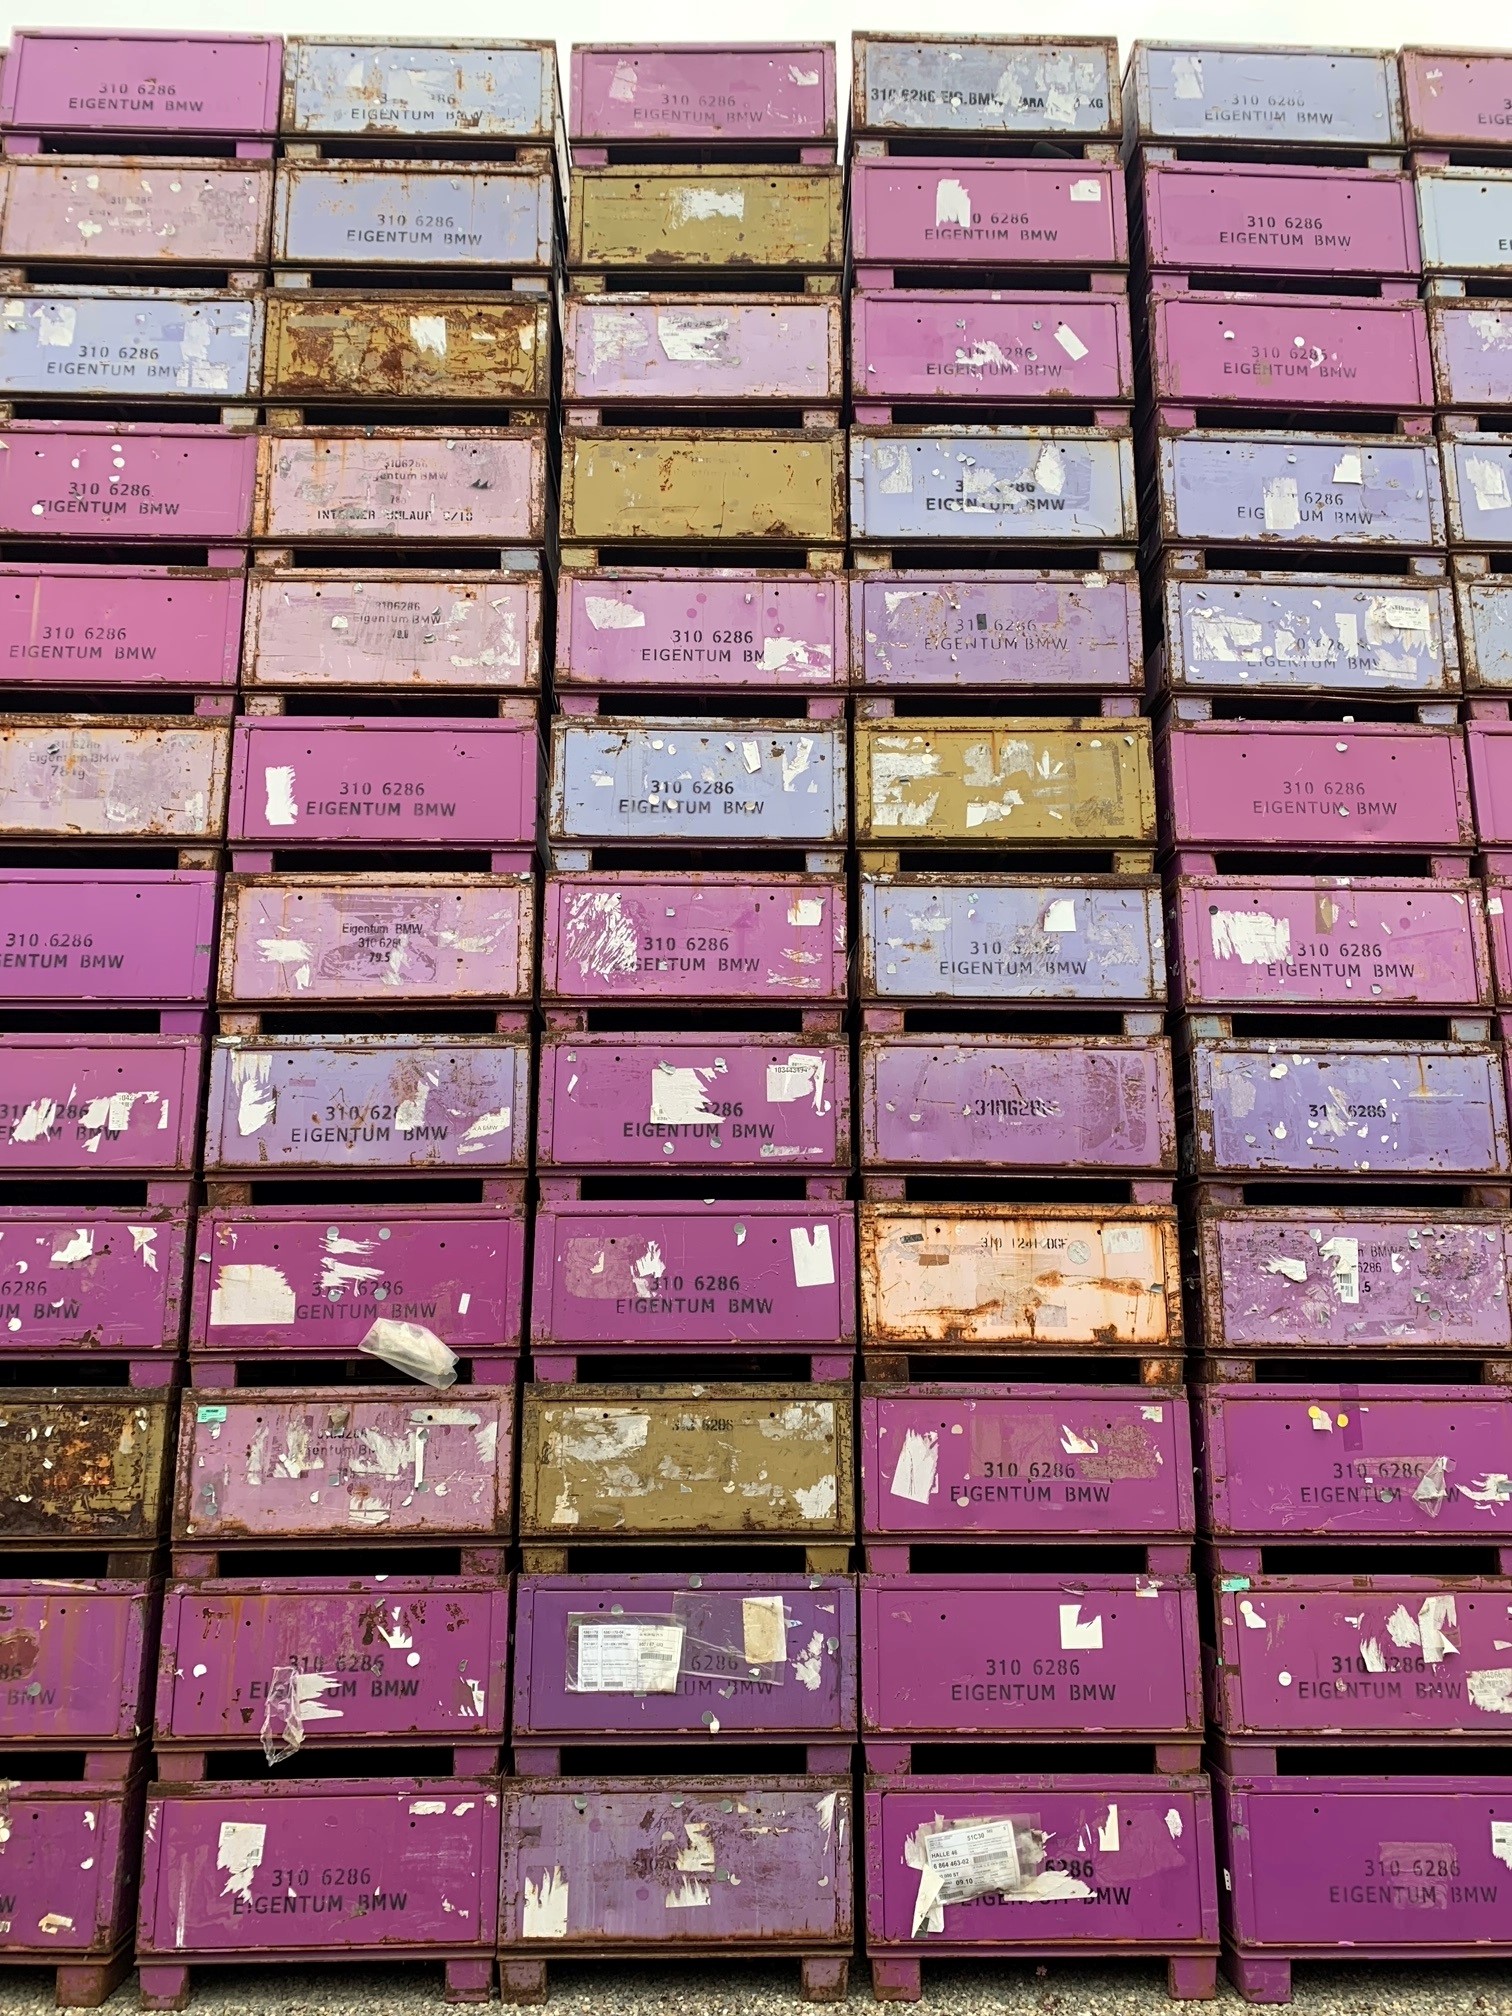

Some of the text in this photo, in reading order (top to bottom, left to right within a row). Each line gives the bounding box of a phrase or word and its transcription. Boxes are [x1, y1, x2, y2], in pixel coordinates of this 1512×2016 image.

[100, 83, 176, 96] 310 6286
[69, 97, 204, 112] EIGENTUM BMW
[661, 94, 735, 107] 310 6286
[1232, 94, 1306, 108] 310 6286
[351, 107, 434, 120] EIGENTUM
[633, 108, 763, 123] EIGENTUM BMW
[1204, 110, 1333, 124] EIGENTUM BMW
[377, 214, 454, 228] 310 6286
[991, 213, 1029, 224] 6286
[1247, 216, 1322, 230] 310 6286
[347, 230, 482, 245] EIGENTUM BMW
[925, 229, 1057, 242] EIGENTUM BMW
[1220, 232, 1351, 247] EIGENTUM BMW
[79, 347, 159, 360] 310 6286
[1252, 346, 1328, 360] 310 6286
[47, 363, 135, 376] EIGENTUM
[1024, 364, 1062, 376] BMW
[1224, 362, 1357, 379] EIGENTUM BMW
[69, 482, 151, 498] 310 6286
[1304, 492, 1343, 505] 6286
[37, 499, 180, 515] EIGENTUM BMW
[1335, 511, 1372, 525] BMW
[412, 615, 440, 624] BMW
[43, 627, 127, 640] 310 6286
[673, 630, 753, 643] 310 6286
[924, 638, 1069, 651] EIGENTUM BMW
[10, 645, 157, 659] EIGENTUM BMW
[642, 648, 764, 663] EIGENTUM BM
[340, 782, 425, 796] 310 6286
[651, 781, 734, 794] 310 6286
[1283, 782, 1365, 795] 310 6286
[306, 802, 456, 817] EIGENTUM BMW
[619, 800, 764, 814] EIGENTUM BMW
[1253, 801, 1397, 815] EIGENTUM BMW
[342, 923, 423, 936] Eigentum BMW
[6, 934, 93, 947] 310 6286
[358, 938, 377, 948] 310
[644, 938, 729, 951] 310 6286
[970, 941, 1002, 954] 310
[370, 952, 390, 963] 79.5
[1298, 944, 1383, 958] 310 6286
[80, 955, 123, 968] BMW
[718, 958, 760, 971] BMW
[940, 962, 1087, 975] EIGENTUM BMW
[1267, 964, 1414, 977] EIGENTUM BMW
[326, 1106, 399, 1121] 310 628
[1348, 1105, 1386, 1118] 6286
[291, 1127, 447, 1143] EIGENTUM BMW
[624, 1123, 775, 1139] EIGENTUM BMW
[1, 1281, 47, 1296] 6286
[649, 1276, 740, 1291] 310 6286
[34, 1304, 80, 1319] BMW
[295, 1303, 437, 1320] GENTUM BMW
[616, 1298, 773, 1314] EIGENTUM BMW
[984, 1463, 1075, 1478] 310 6286
[1333, 1464, 1424, 1479] 310 6286
[950, 1486, 1110, 1501] EIGENTUM BMW
[1301, 1488, 1400, 1502] EIGENTUM
[289, 1655, 385, 1672] 310 6286
[691, 1655, 738, 1671] 6286
[986, 1659, 1080, 1676] 310 6286
[371, 1681, 418, 1697] BMW
[952, 1684, 1116, 1700] EIGENTUM BMW
[1299, 1682, 1461, 1699] EIGENTUM BMW
[967, 1832, 985, 1842] 51C30
[931, 1851, 950, 1859] HALLE
[1364, 1860, 1461, 1877] 310 6286
[272, 1869, 371, 1886] 310 6286
[956, 1878, 973, 1886] 09.10
[1329, 1887, 1497, 1904] EIGENTUM BMW
[233, 1893, 407, 1914] EIGENTUM BMW
